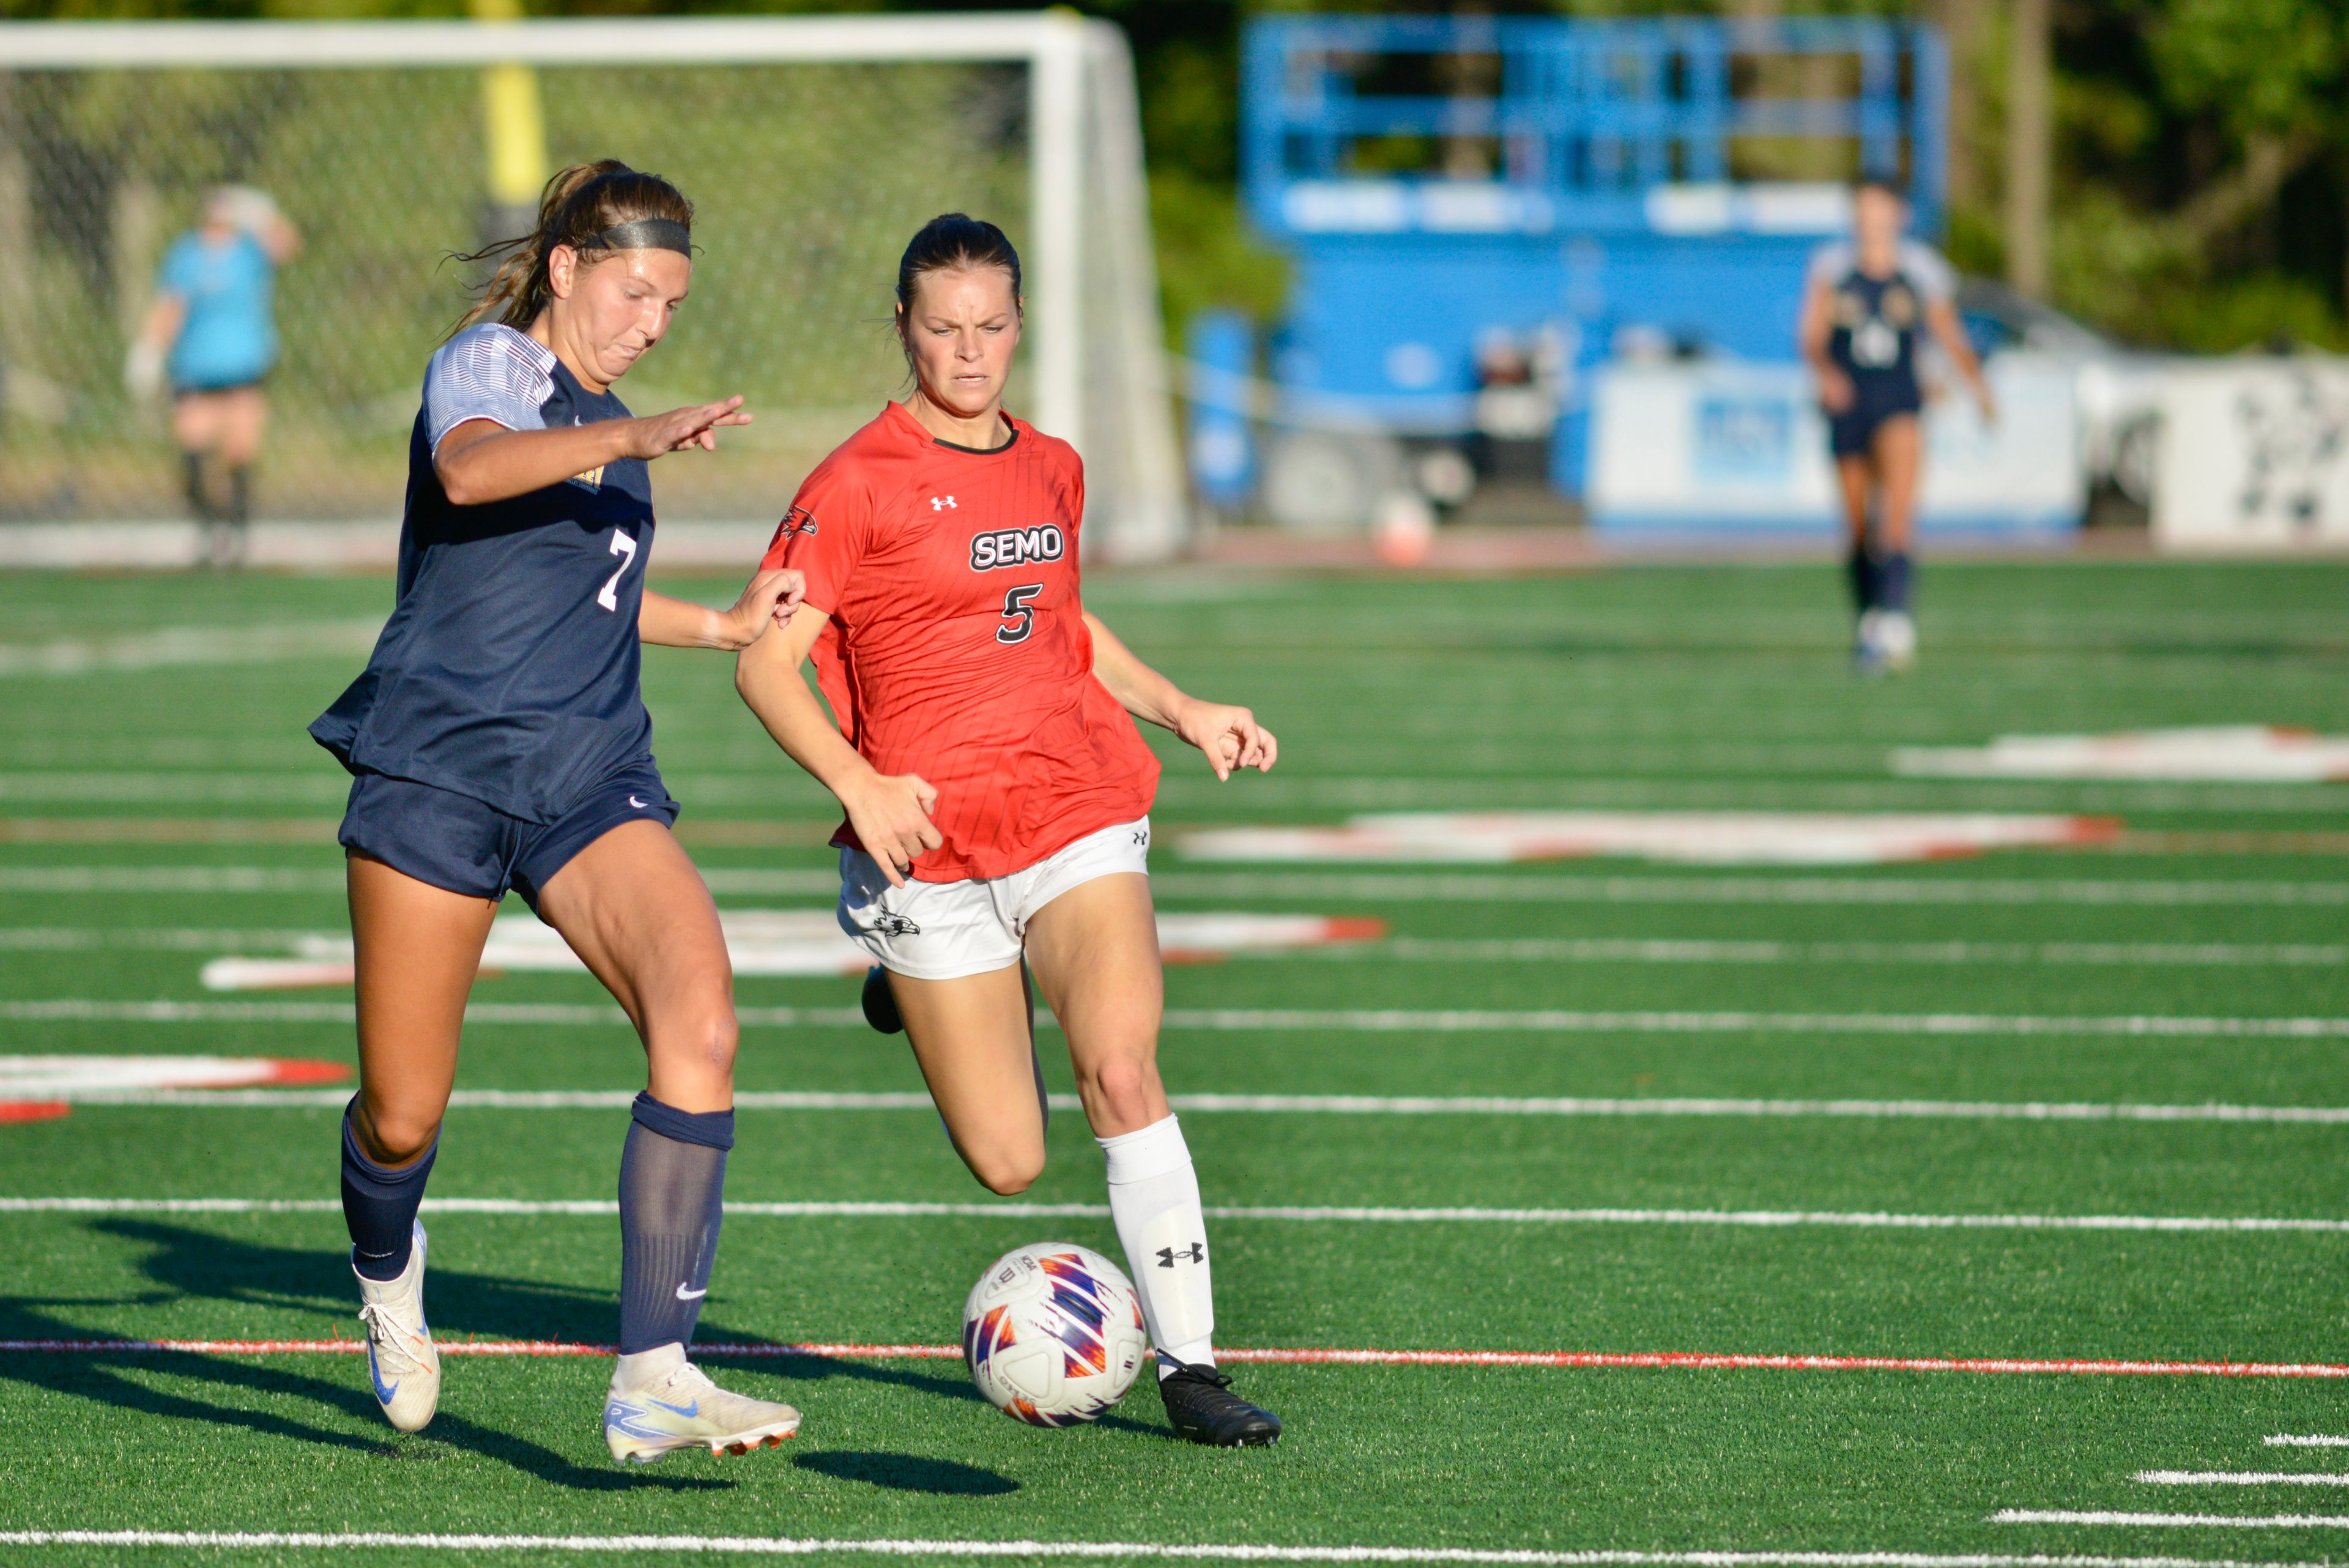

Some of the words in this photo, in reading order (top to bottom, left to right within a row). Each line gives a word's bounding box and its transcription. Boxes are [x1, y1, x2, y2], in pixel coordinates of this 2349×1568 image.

[598, 529, 637, 612] 7
[972, 526, 1063, 569] SEMO
[996, 583, 1044, 644] 5
[1020, 1255, 1037, 1271] NCAA
